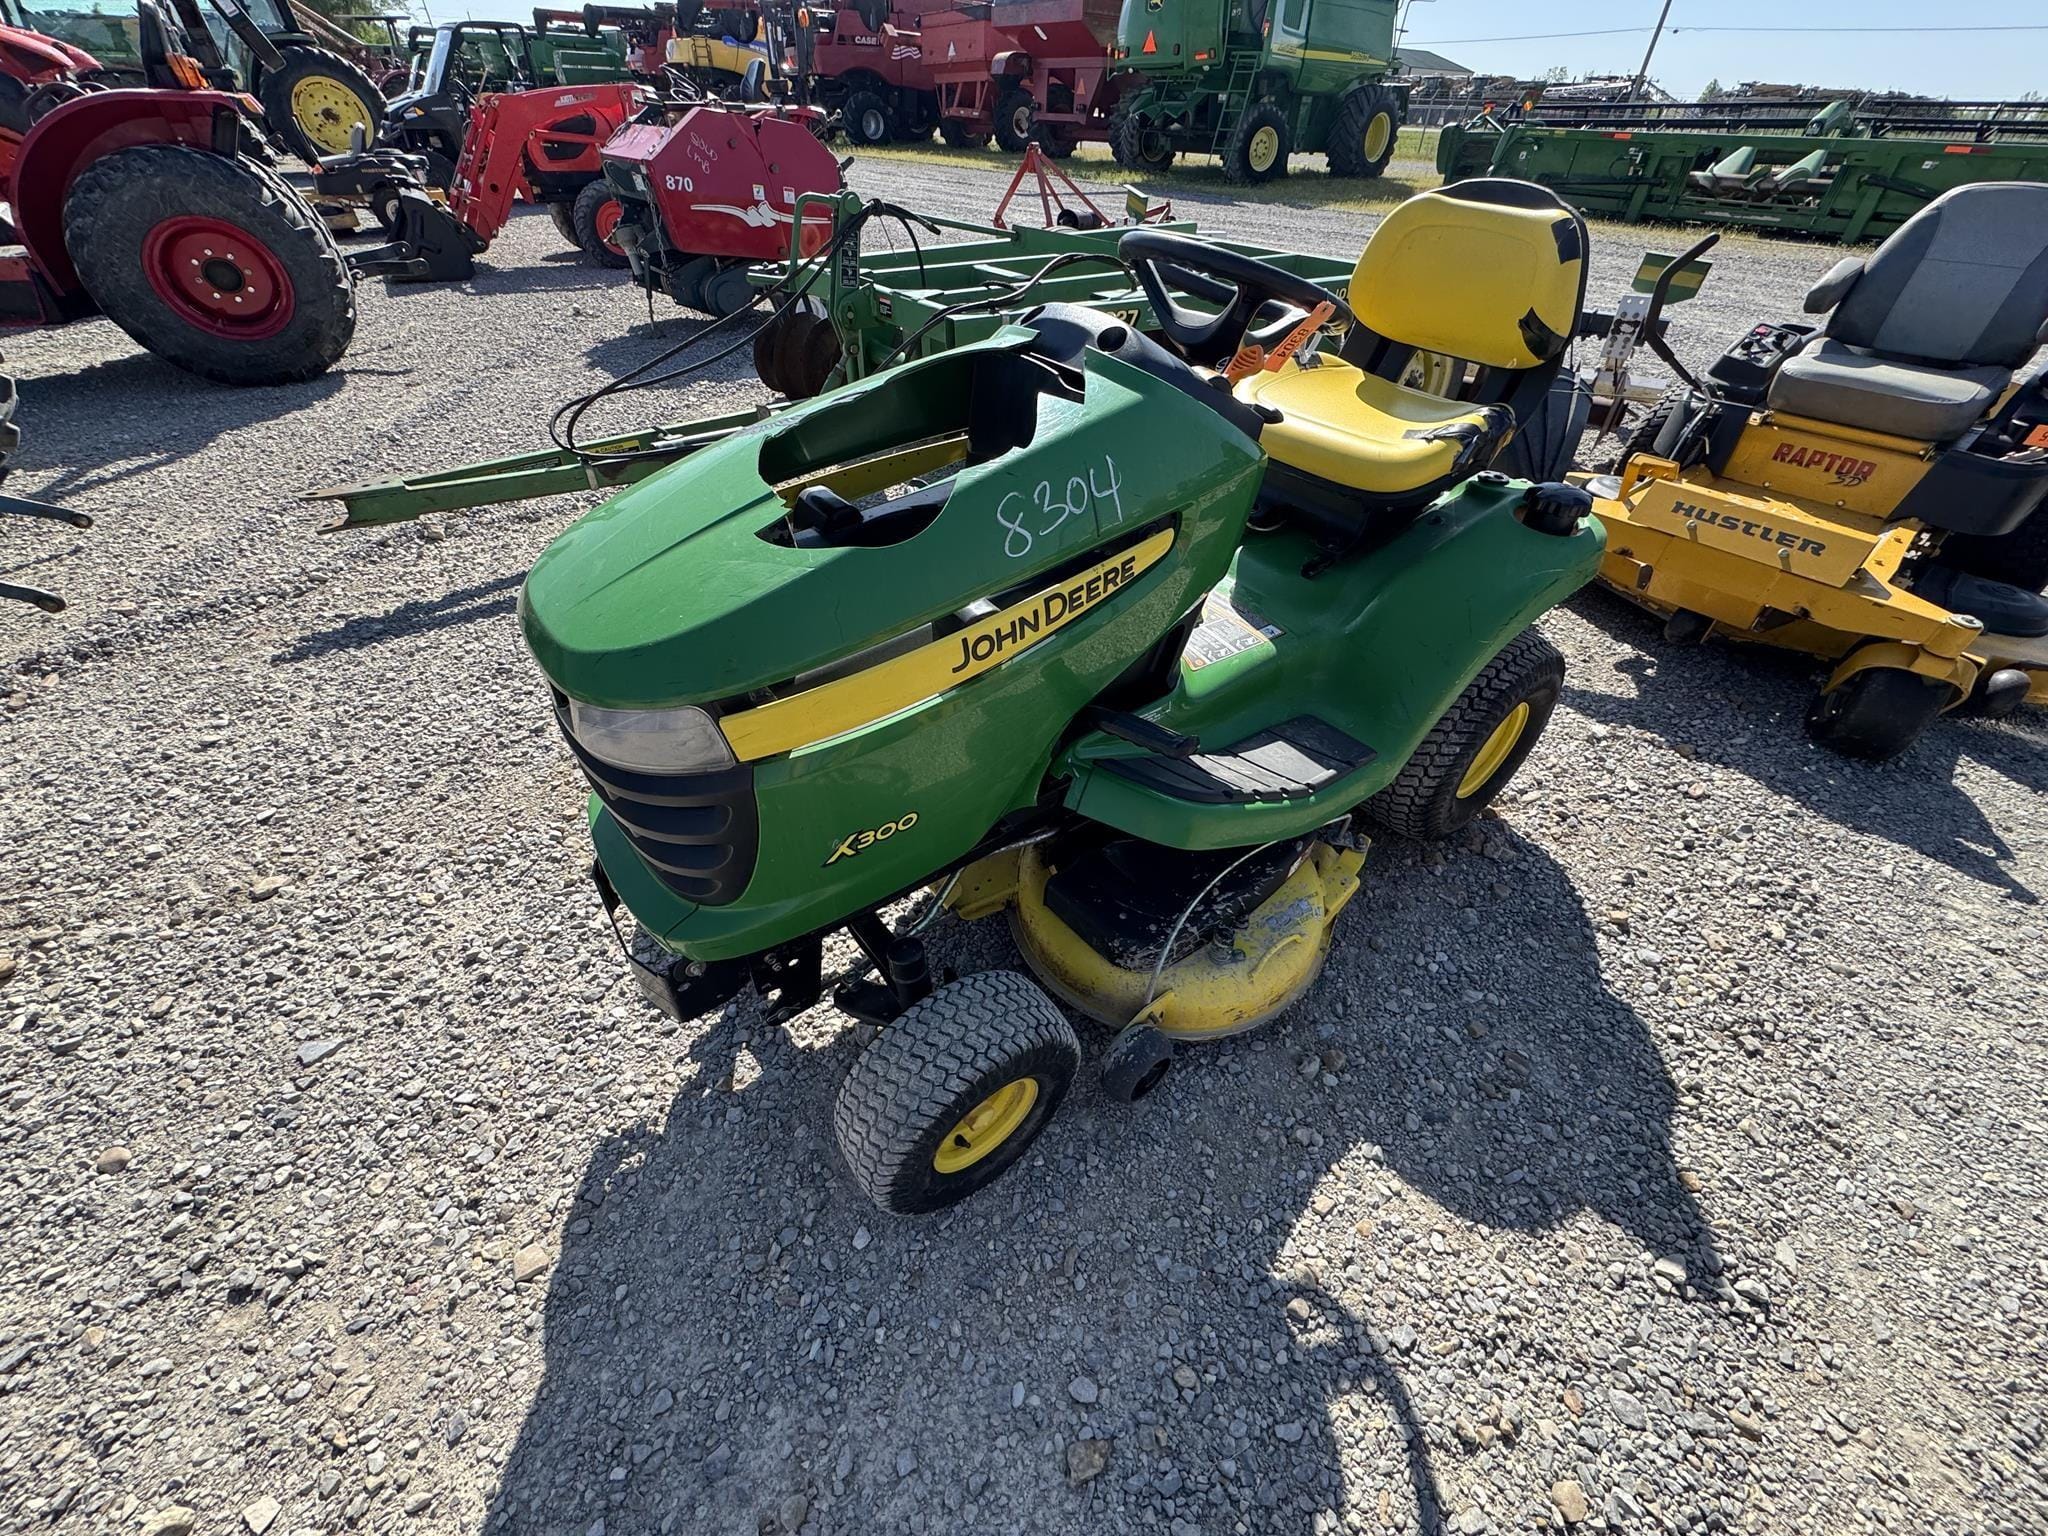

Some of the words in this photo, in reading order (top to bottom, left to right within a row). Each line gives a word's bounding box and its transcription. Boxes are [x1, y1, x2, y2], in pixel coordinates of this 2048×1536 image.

[854, 35, 878, 46] CASE
[665, 174, 694, 193] 870
[1277, 327, 1310, 358] 8304
[1771, 442, 1877, 482] RAPTOR
[1824, 473, 1864, 488] SD
[996, 454, 1122, 558] 8304
[1670, 500, 1827, 557] HUSTLER
[951, 608, 1040, 674] JOHN
[1042, 555, 1136, 627] DEERE
[822, 811, 919, 866] X300
